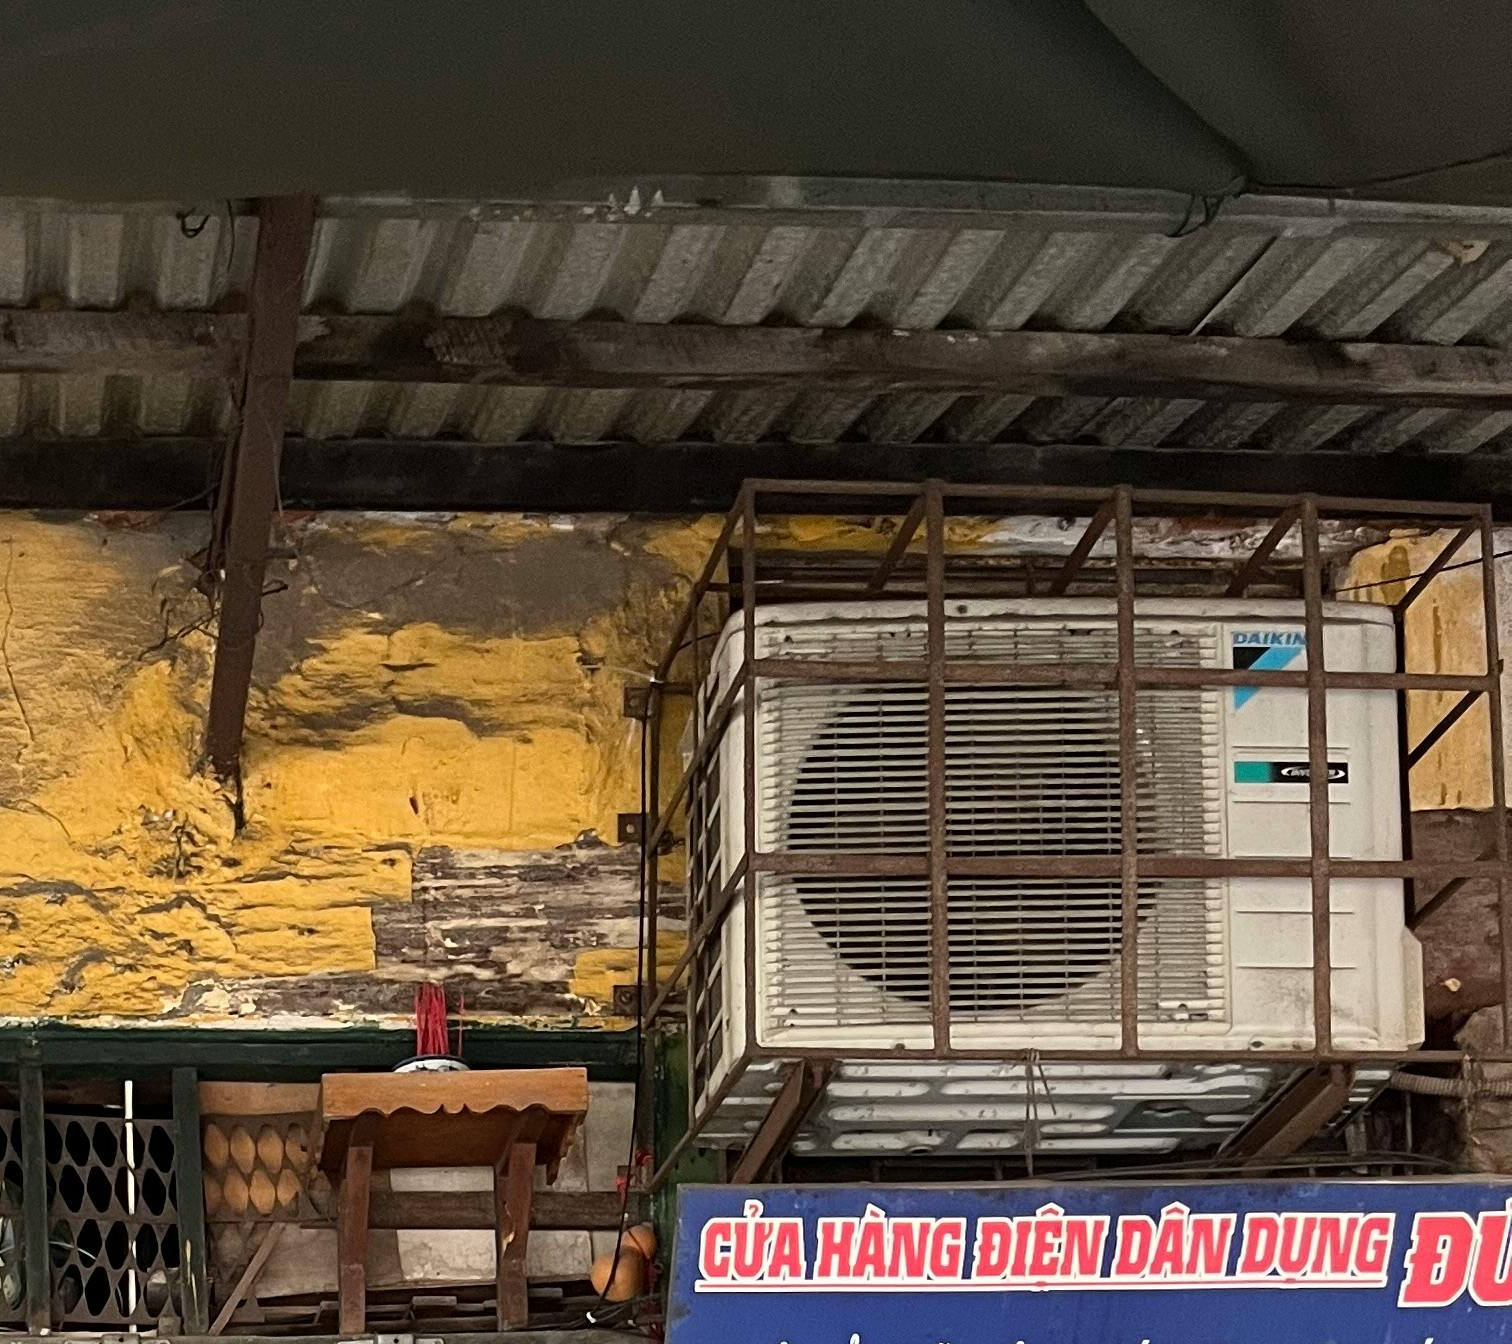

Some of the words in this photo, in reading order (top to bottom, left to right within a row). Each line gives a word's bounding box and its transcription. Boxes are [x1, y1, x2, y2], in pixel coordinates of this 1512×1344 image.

[1232, 631, 1308, 645] DAIKIN
[699, 1199, 807, 1280] CỬA
[814, 1203, 967, 1280] HÀNG
[1112, 1201, 1236, 1279] DÂN
